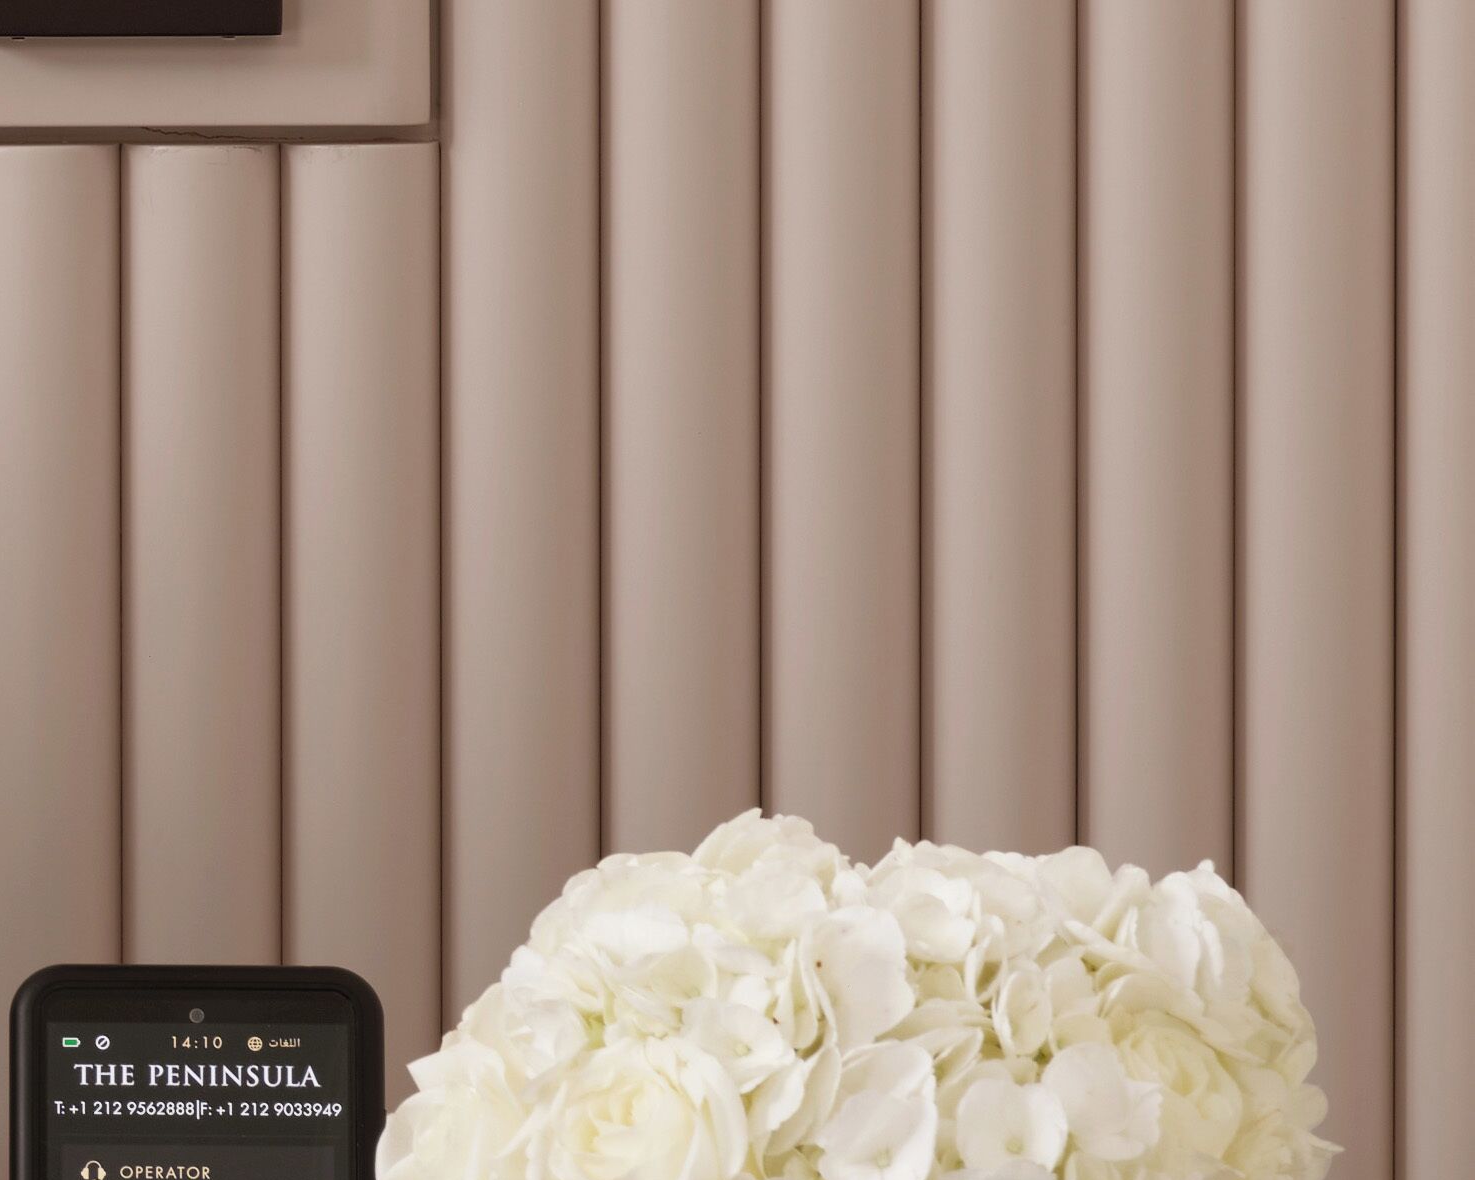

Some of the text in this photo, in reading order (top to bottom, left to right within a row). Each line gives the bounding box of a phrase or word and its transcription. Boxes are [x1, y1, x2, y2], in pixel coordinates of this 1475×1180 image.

[173, 1036, 222, 1048] 14:10
[269, 1038, 300, 1047] اللغات
[74, 1064, 320, 1087] THE PENINSULA
[55, 1101, 65, 1114] T:
[69, 1101, 85, 1114] +1
[94, 1101, 121, 1115] 212
[217, 1102, 232, 1115] +1
[241, 1103, 269, 1116] 212
[274, 1103, 342, 1116] 9033949
[120, 1166, 210, 1179] OPERATOR
